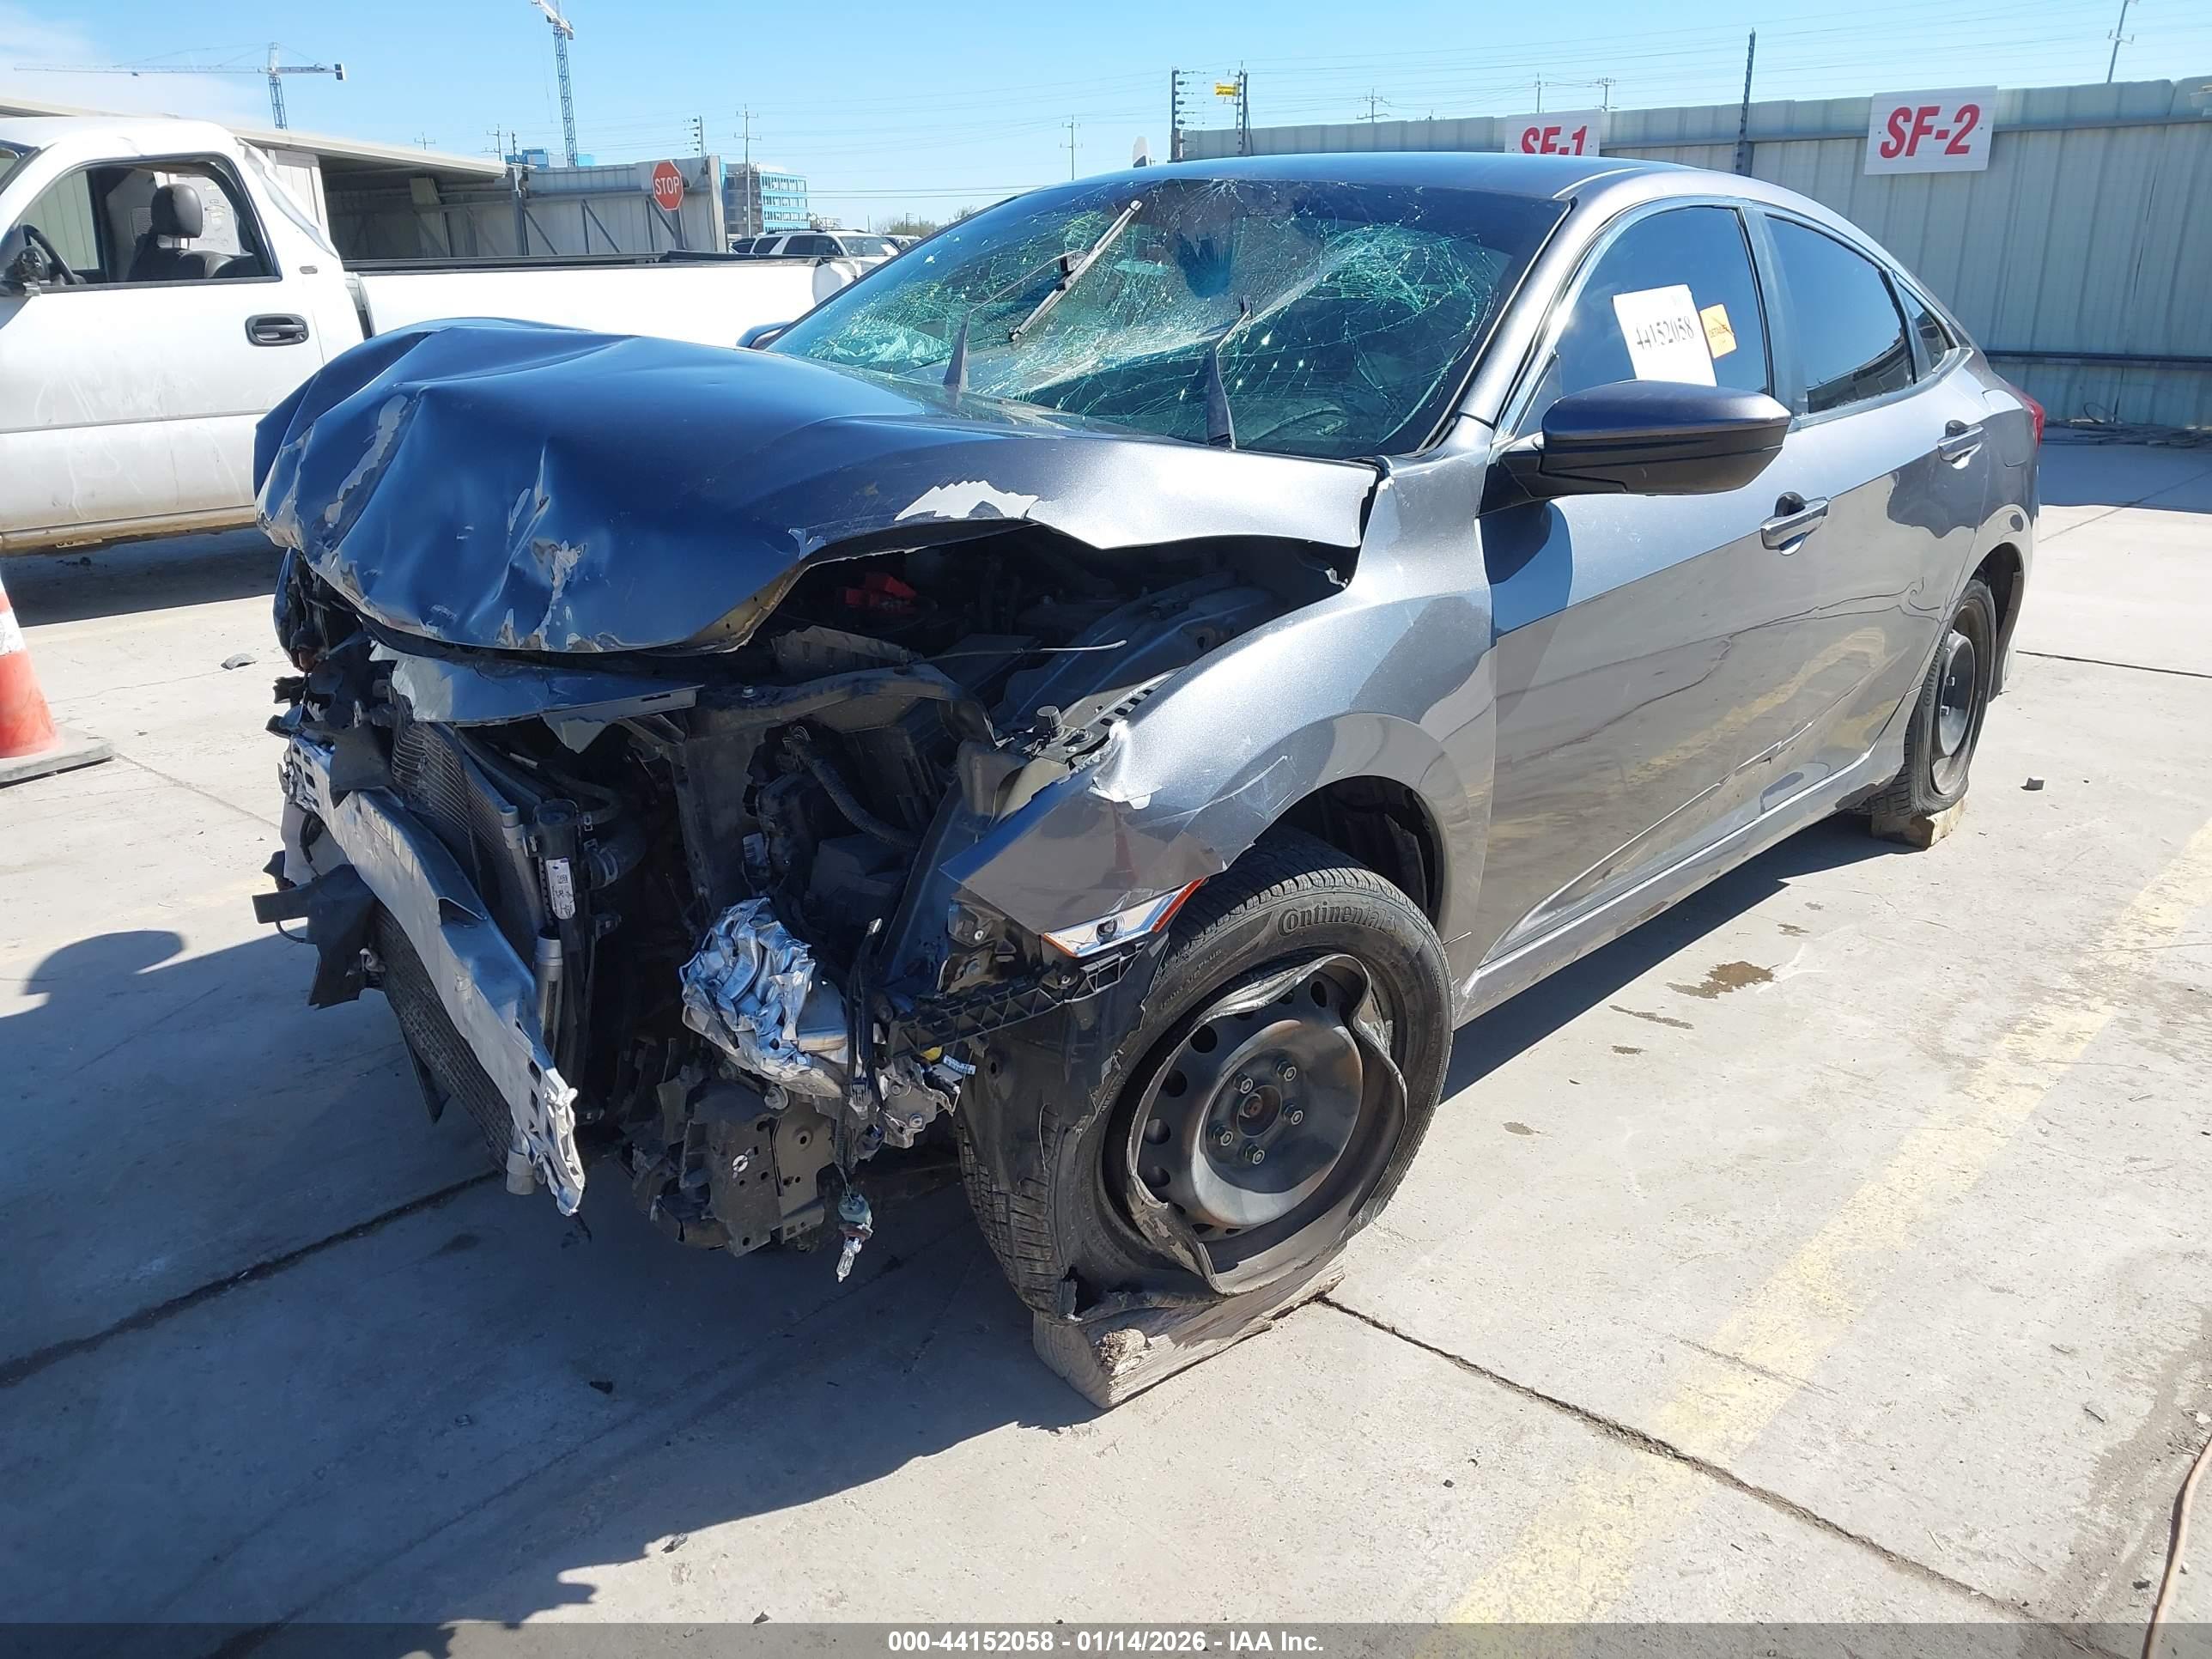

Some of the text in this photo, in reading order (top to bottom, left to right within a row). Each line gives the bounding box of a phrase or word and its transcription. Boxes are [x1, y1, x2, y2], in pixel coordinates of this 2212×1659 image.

[1522, 125, 1588, 155] SF-1
[1880, 104, 1980, 158] SF-2
[654, 175, 679, 196] STOP
[1636, 315, 1695, 350] 44152058
[1277, 901, 1387, 937] Continental
